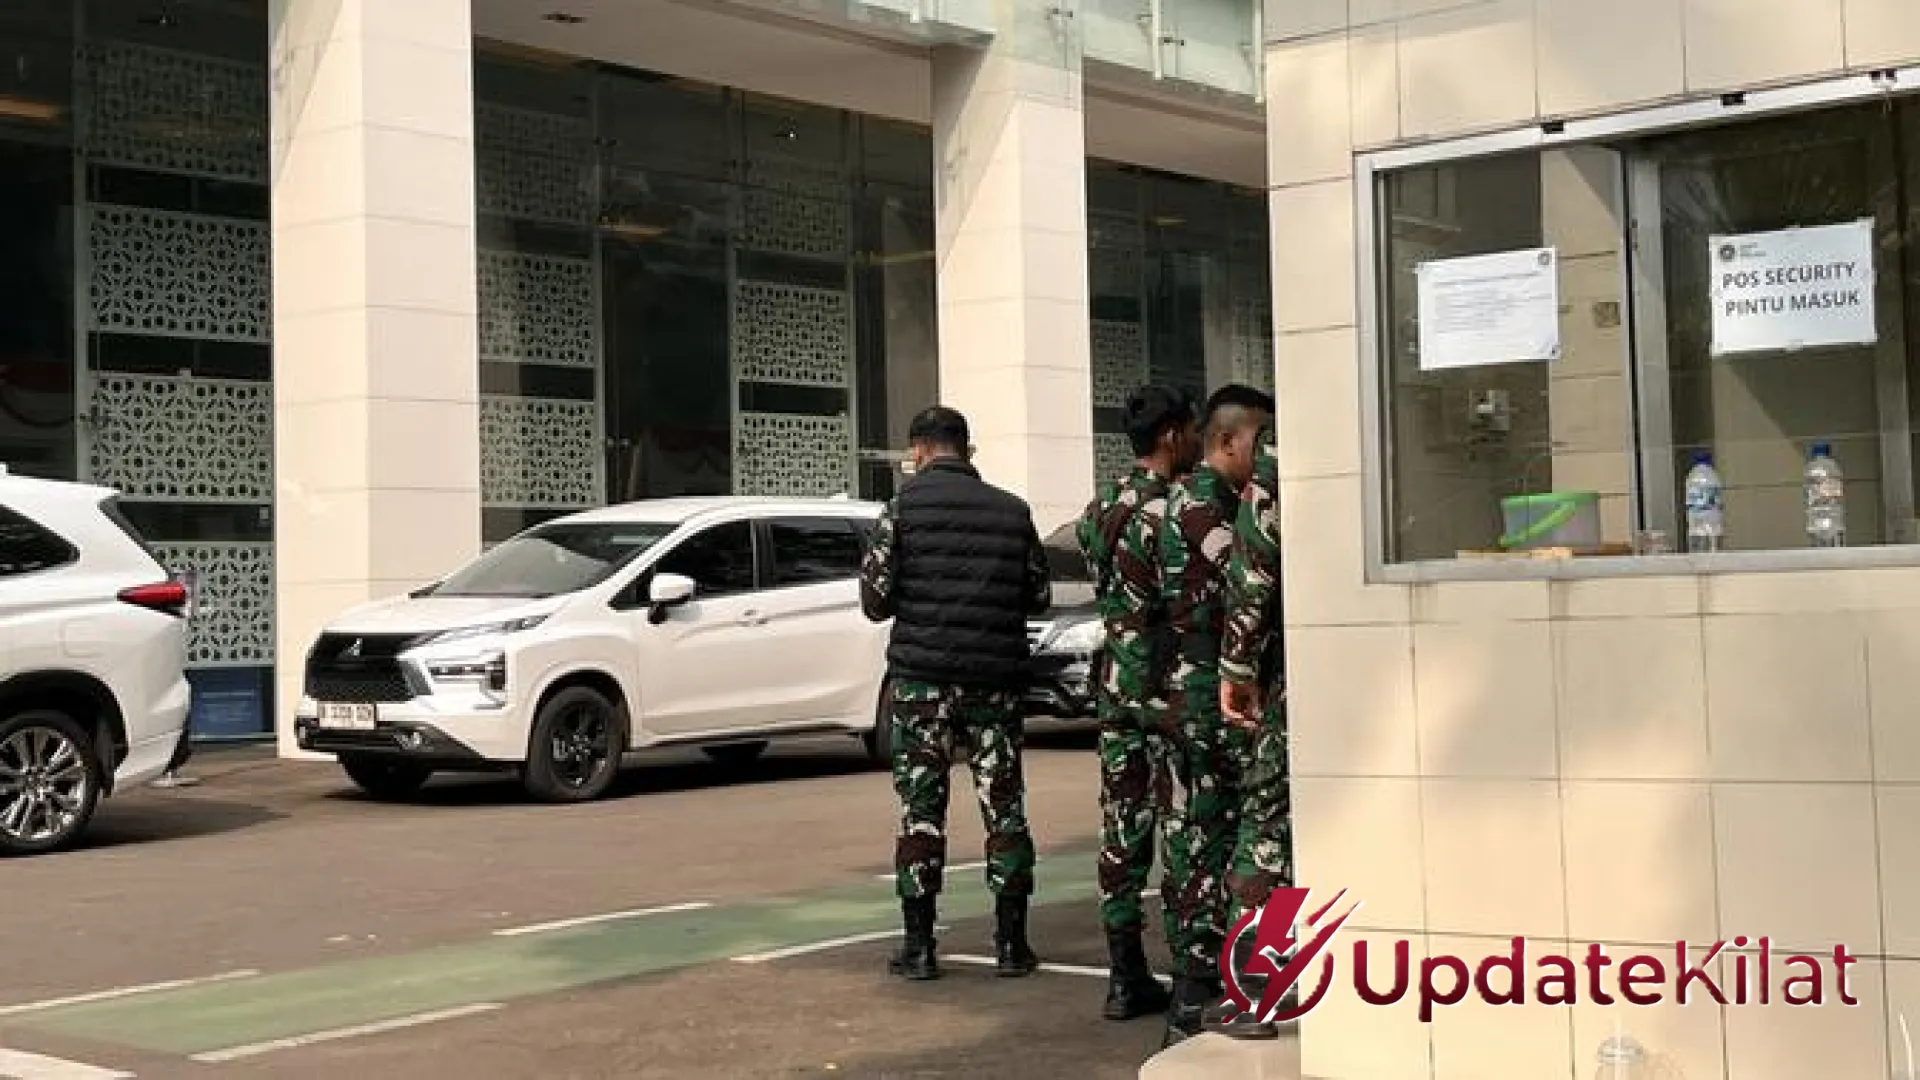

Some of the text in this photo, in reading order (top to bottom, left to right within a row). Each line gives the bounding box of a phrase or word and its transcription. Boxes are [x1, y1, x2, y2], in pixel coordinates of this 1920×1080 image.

[1722, 262, 1856, 289] POS SECURITY
[1726, 290, 1860, 316] PINTU MASUK
